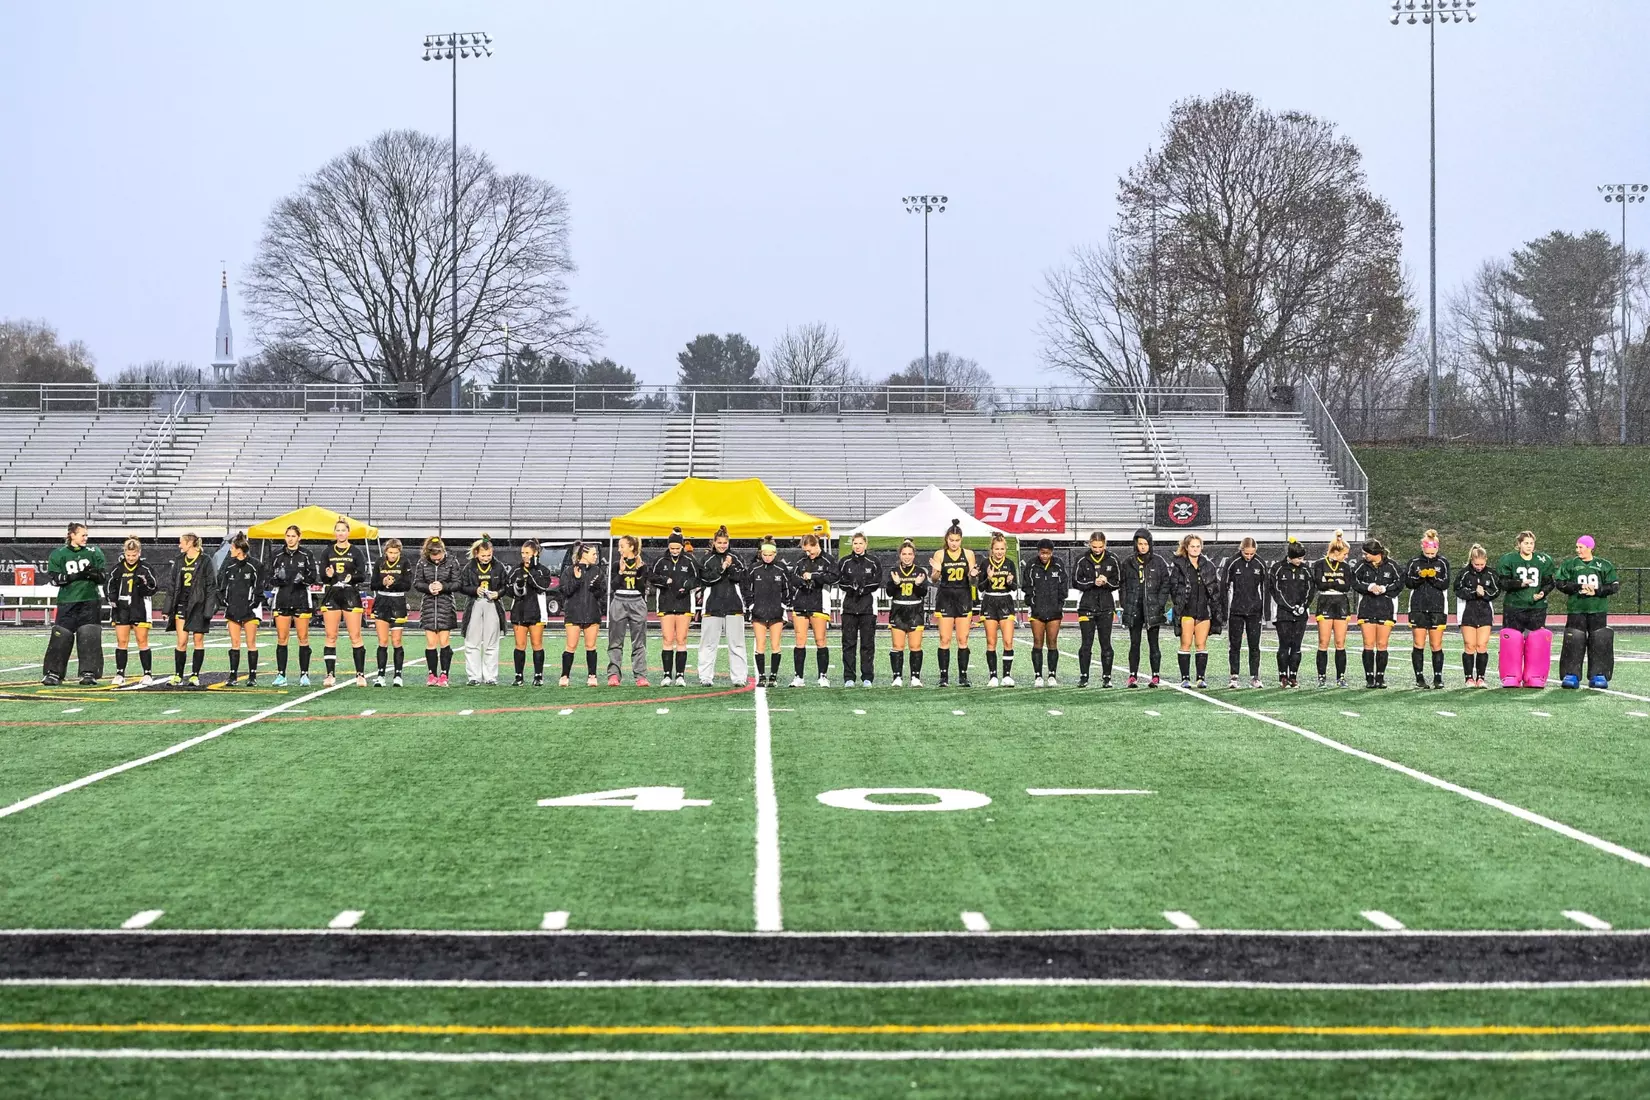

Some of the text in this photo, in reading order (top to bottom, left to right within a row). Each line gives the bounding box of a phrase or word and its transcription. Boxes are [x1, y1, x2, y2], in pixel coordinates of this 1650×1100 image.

[980, 497, 1061, 523] STX
[335, 562, 345, 573] 5
[947, 567, 964, 581] 20
[184, 572, 192, 587] 2
[624, 576, 635, 589] 11
[991, 576, 1006, 590] 22
[1516, 566, 1539, 587] 33
[127, 578, 133, 593] 1
[900, 582, 913, 596] 18
